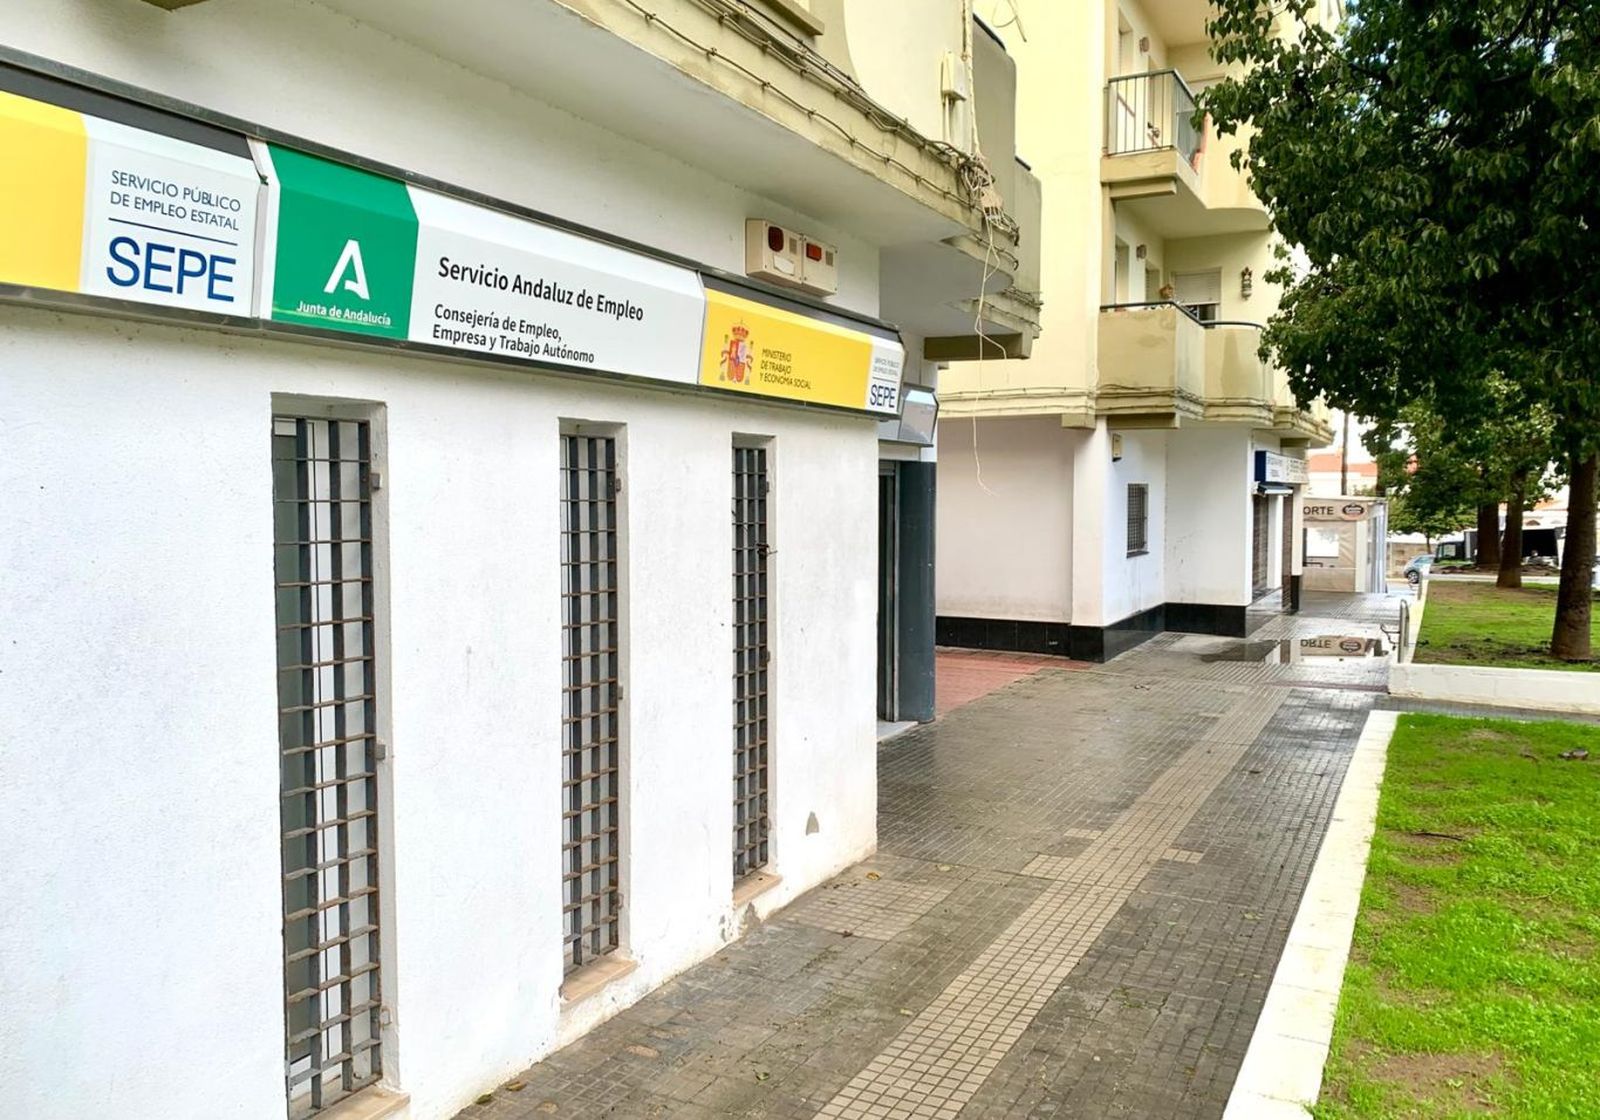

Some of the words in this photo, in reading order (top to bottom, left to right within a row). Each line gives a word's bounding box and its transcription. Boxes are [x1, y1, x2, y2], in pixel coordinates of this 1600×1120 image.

[110, 190, 130, 208] DE
[134, 195, 187, 220] EMPLEO
[190, 208, 239, 232] ESTATAL
[111, 169, 179, 198] SERVICIO
[182, 185, 241, 212] PÚBLICO
[106, 236, 237, 303] SEPE
[438, 256, 508, 291] Servicio
[511, 274, 574, 306] Andaluz
[576, 288, 594, 310] de
[596, 293, 644, 321] Empleo
[296, 300, 327, 316] Junta
[328, 305, 343, 318] de
[343, 307, 392, 326] Andalucía
[434, 303, 500, 329] Consejería
[502, 315, 517, 332] de
[519, 319, 562, 343] Empleo,
[432, 323, 487, 345] Empresa
[489, 335, 497, 351] y
[499, 334, 541, 357] Trabajo
[542, 342, 595, 363] Autónomo
[869, 383, 897, 409] SEPE
